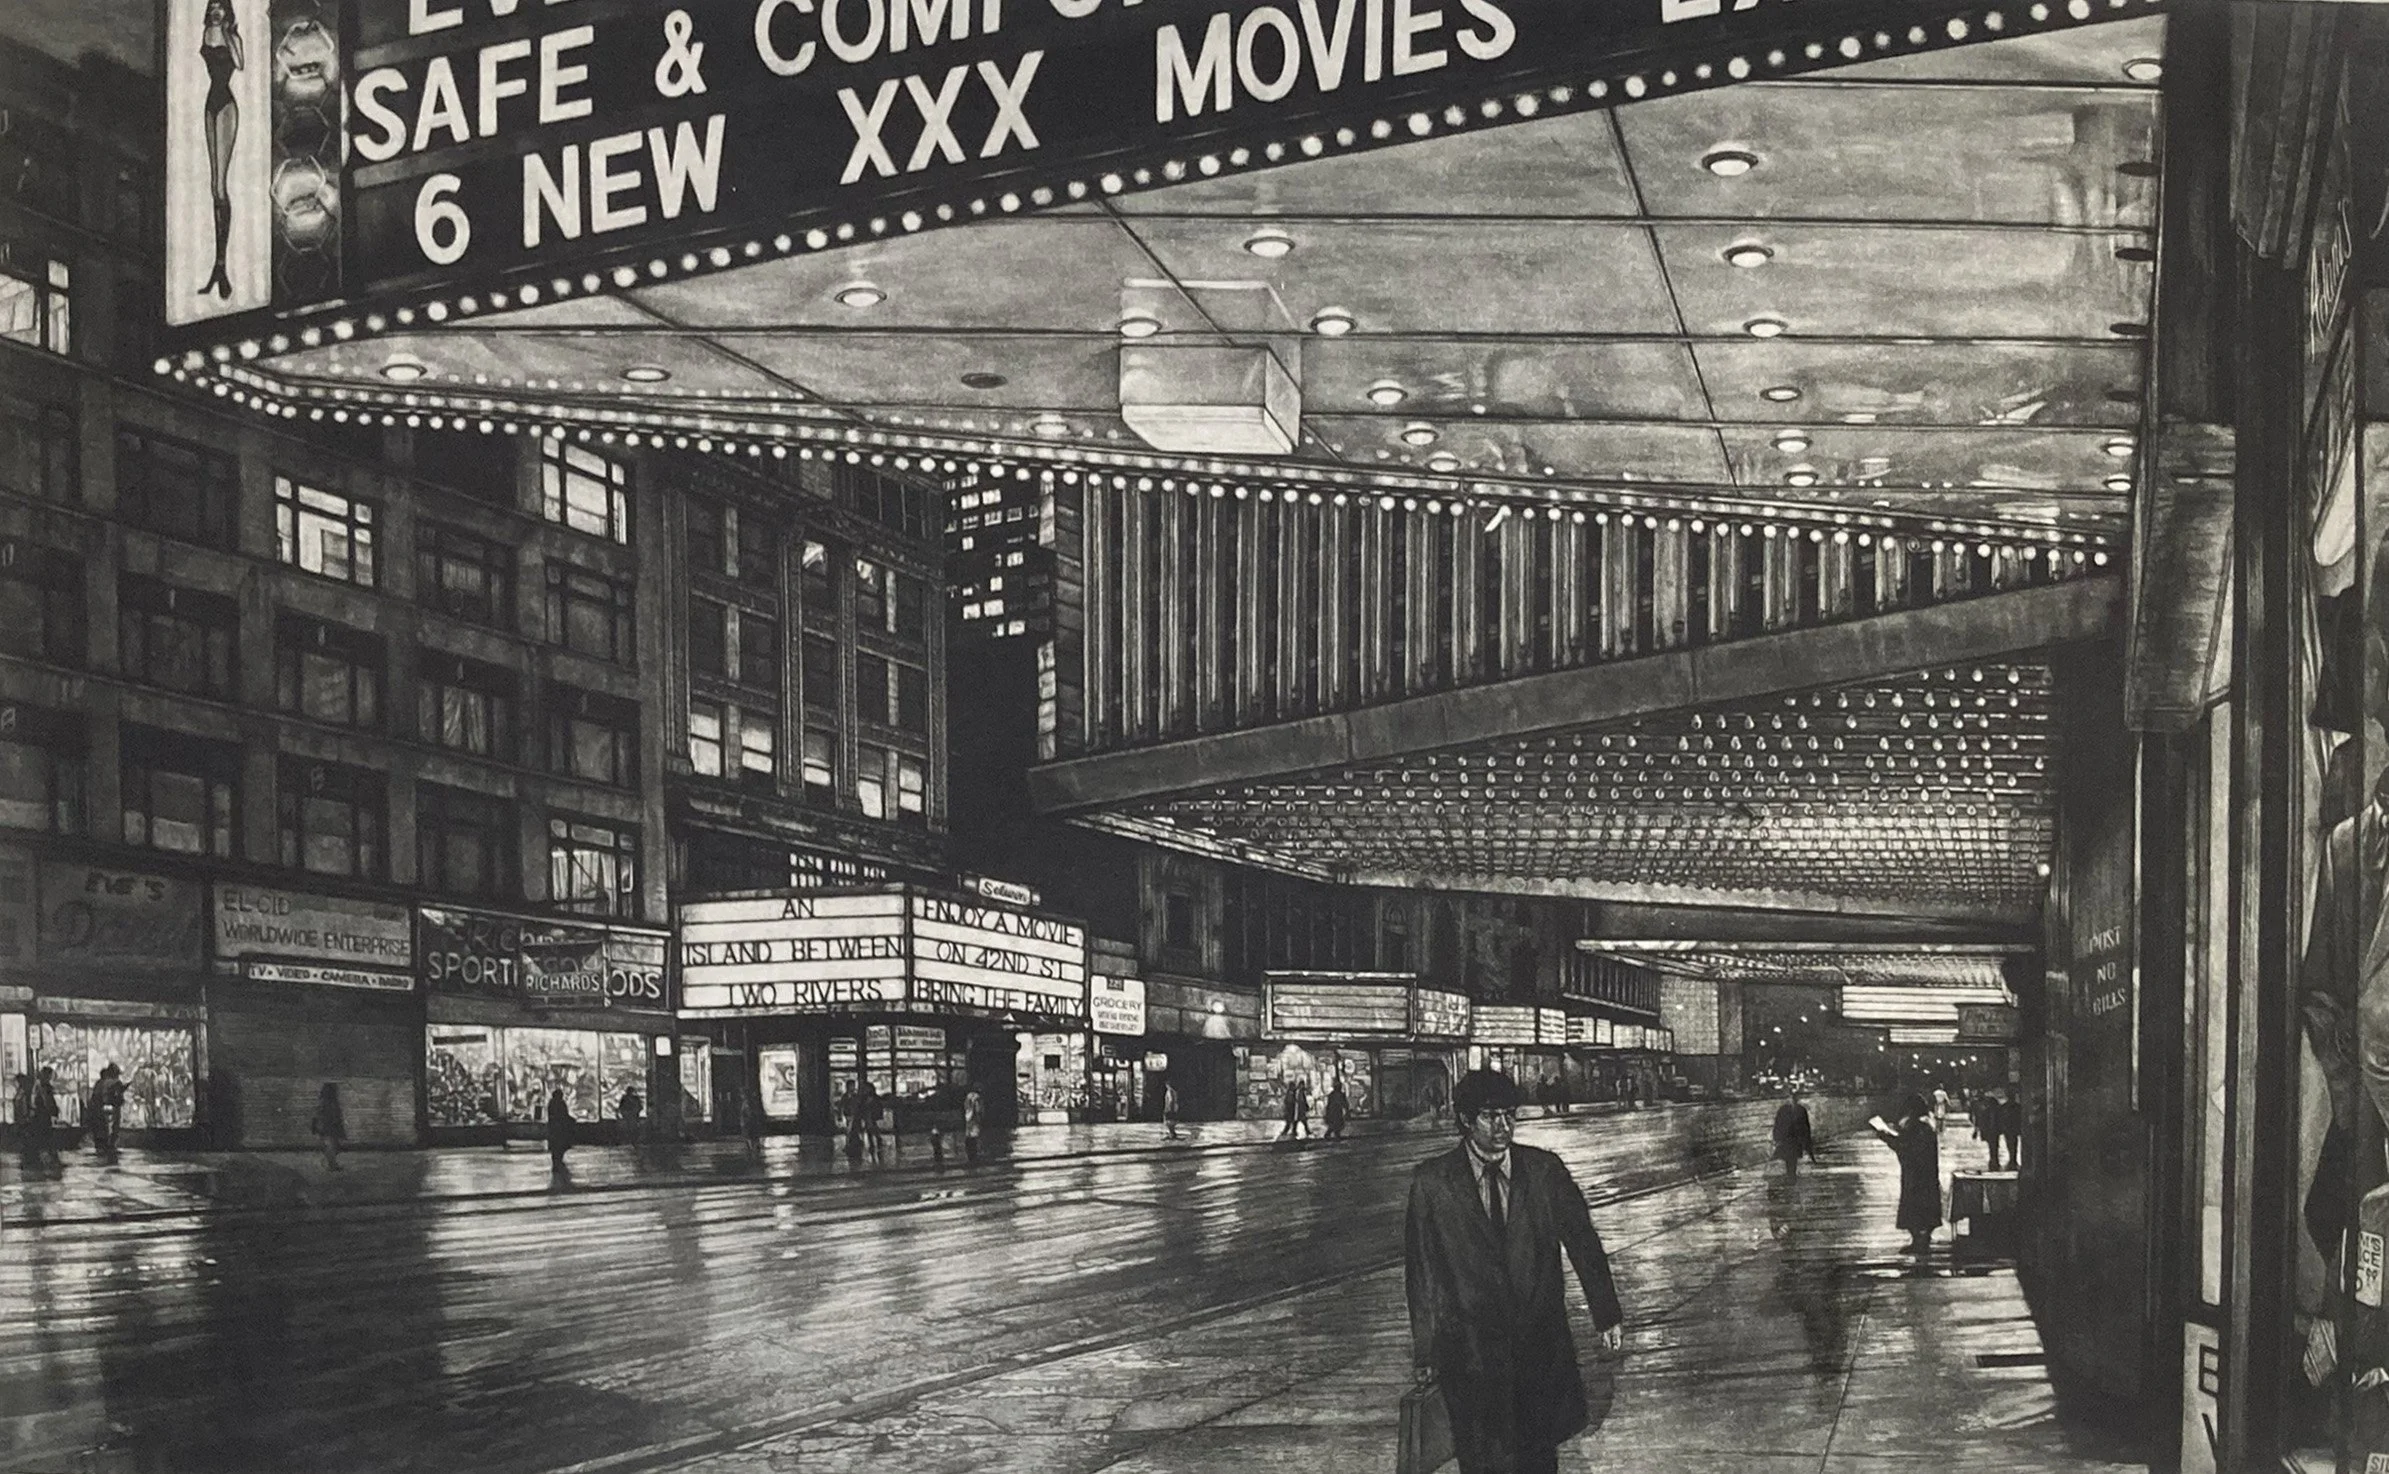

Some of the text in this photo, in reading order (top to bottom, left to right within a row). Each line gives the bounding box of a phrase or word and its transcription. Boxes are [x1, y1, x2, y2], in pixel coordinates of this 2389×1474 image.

[352, 25, 595, 162] SAFE
[655, 10, 706, 98] &
[413, 0, 1517, 267] 6 NEW XXX MOVIES
[224, 888, 291, 916] EL CID
[781, 898, 815, 918] AN
[923, 898, 1080, 947] ENJOY A MOVIE
[224, 920, 319, 948] WORLDWIDE
[323, 932, 411, 957] ENTERPRISE
[686, 936, 902, 966] ISLAND BETWEEN
[2088, 925, 2121, 954] POST
[427, 951, 519, 987] SPORTI
[936, 941, 1064, 980] ON 42ND ST
[2096, 961, 2116, 985] NO
[526, 973, 601, 993] RICHARDS
[728, 978, 883, 1006] TWO RIVERS
[916, 978, 1084, 1017] BRING THE FAMILY
[1092, 996, 1143, 1011] GROCERY
[2092, 987, 2127, 1016] BILLS
